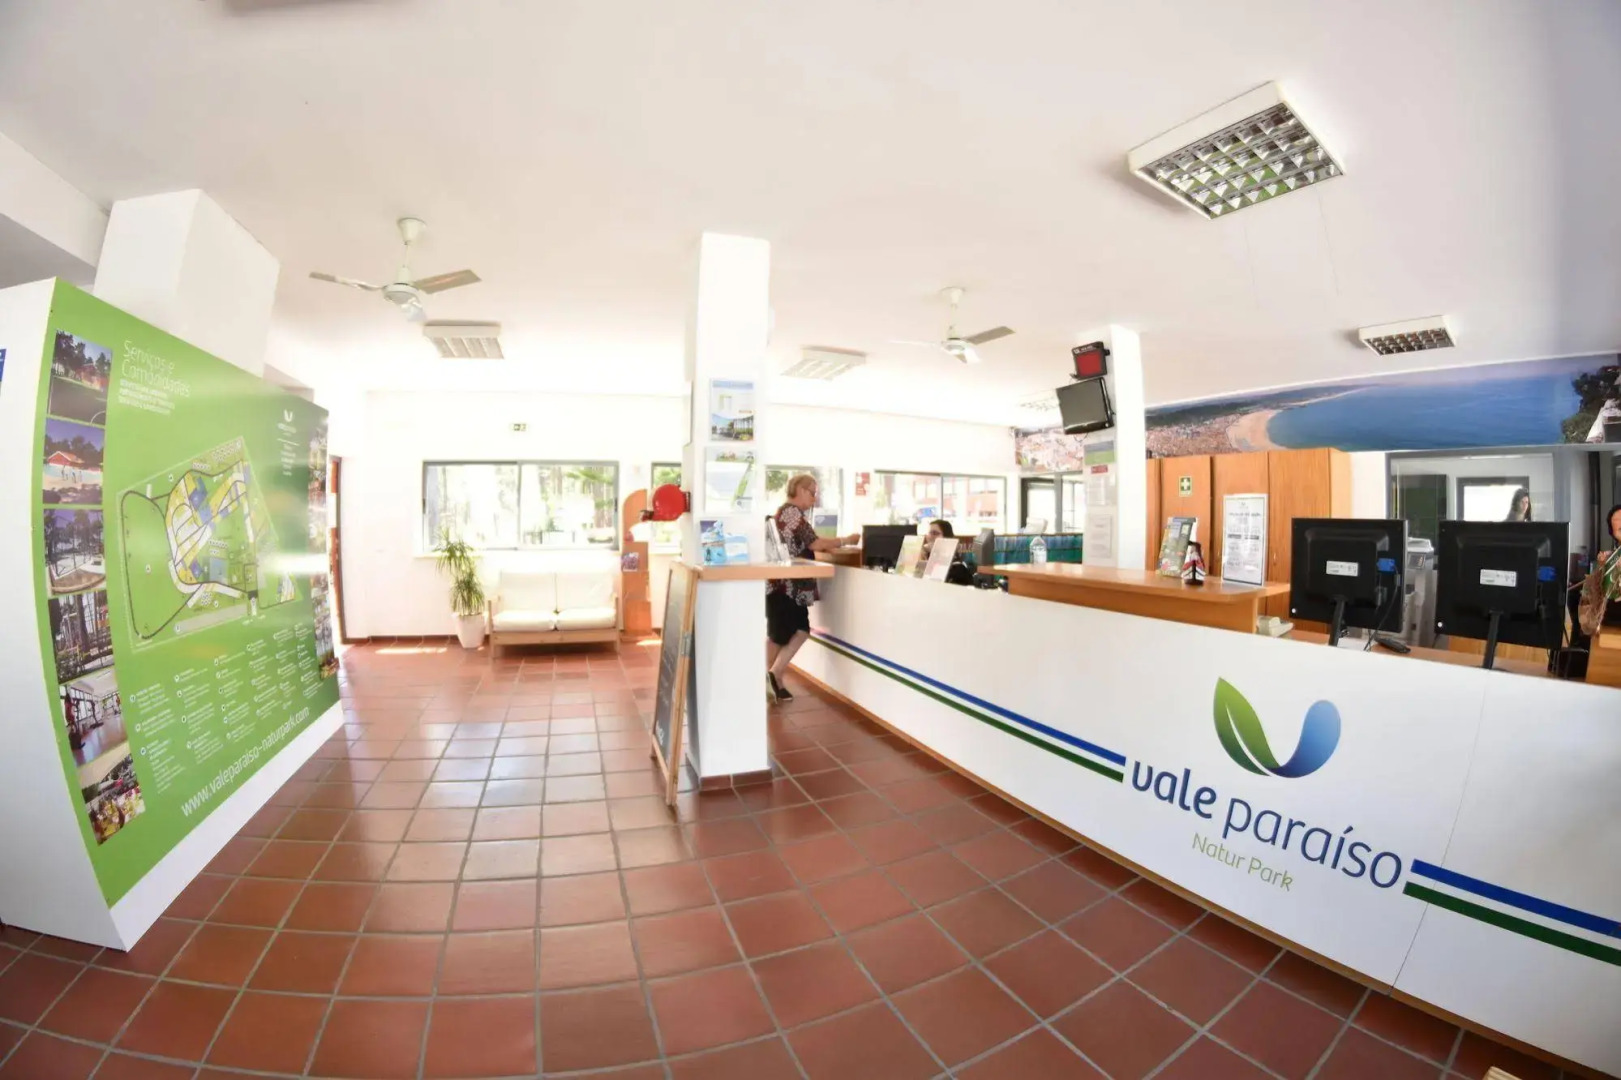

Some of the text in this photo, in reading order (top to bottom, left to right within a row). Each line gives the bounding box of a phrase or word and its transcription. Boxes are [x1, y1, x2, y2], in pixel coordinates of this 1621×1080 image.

[123, 339, 167, 372] Serviços
[181, 706, 310, 817] www.valeparaiso-naturpark.com
[1191, 832, 1294, 892] Natur Park
[1222, 797, 1402, 889] paraíso
